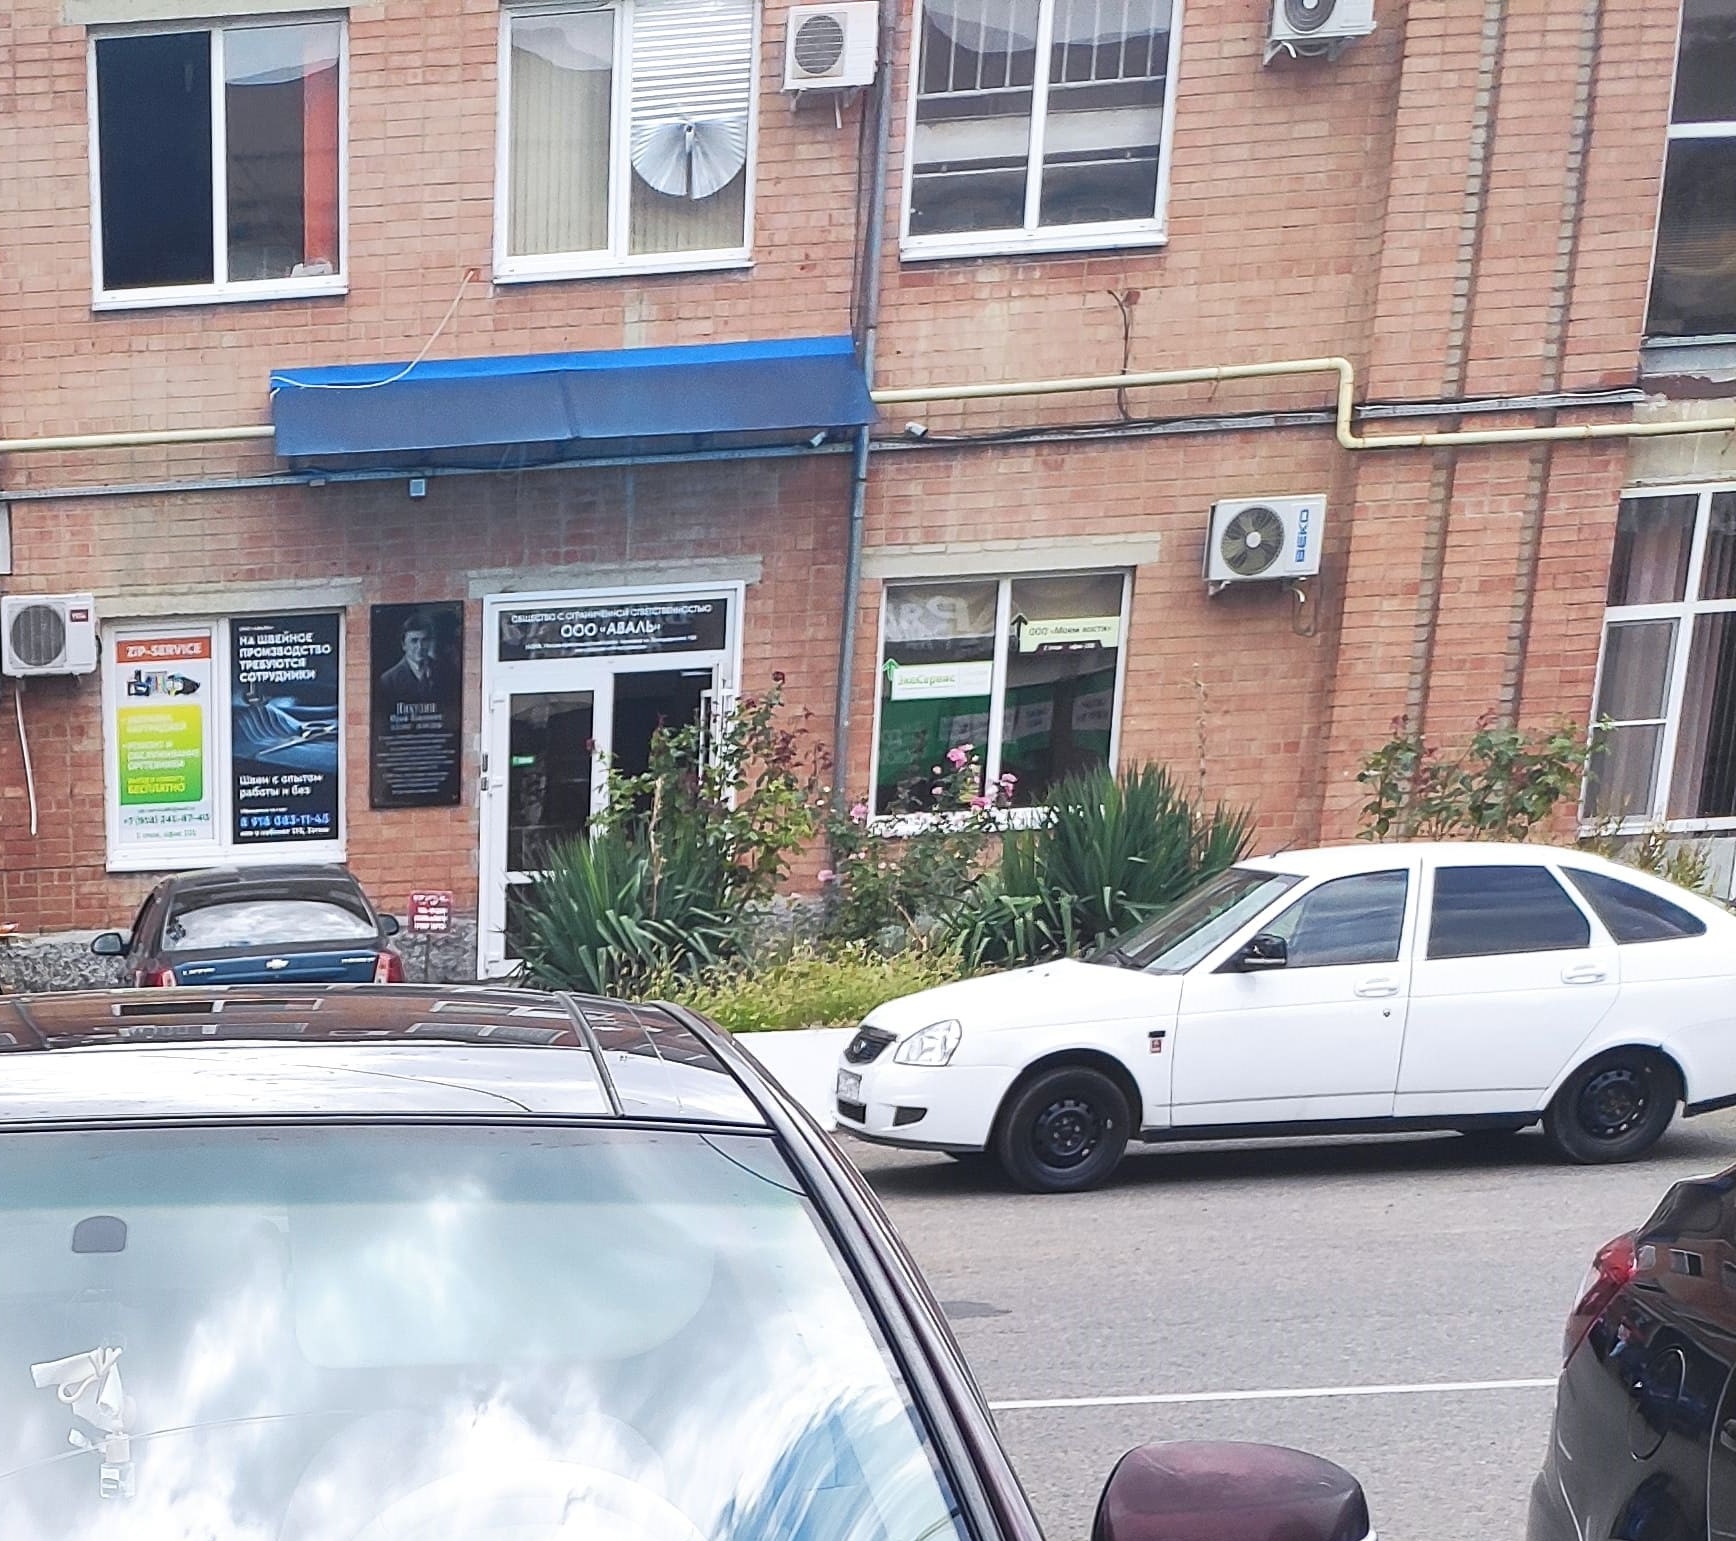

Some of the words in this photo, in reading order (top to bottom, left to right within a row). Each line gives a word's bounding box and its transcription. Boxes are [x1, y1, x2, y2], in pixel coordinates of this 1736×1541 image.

[1295, 508, 1309, 562] BEKO
[560, 623, 598, 638] ООО
[599, 619, 661, 636] «АВАЛЬ»
[239, 635, 255, 646] НА
[256, 630, 314, 645] ШВЕЙНОЕ
[126, 642, 203, 658] ZIP-SERVICE
[239, 644, 332, 658] ПРОИЗВОДСТВО
[239, 657, 306, 671] ТРЕБУЮТСЯ
[239, 669, 317, 683] СОТРУДНИКИ
[239, 785, 280, 800] работы
[291, 784, 312, 796] без
